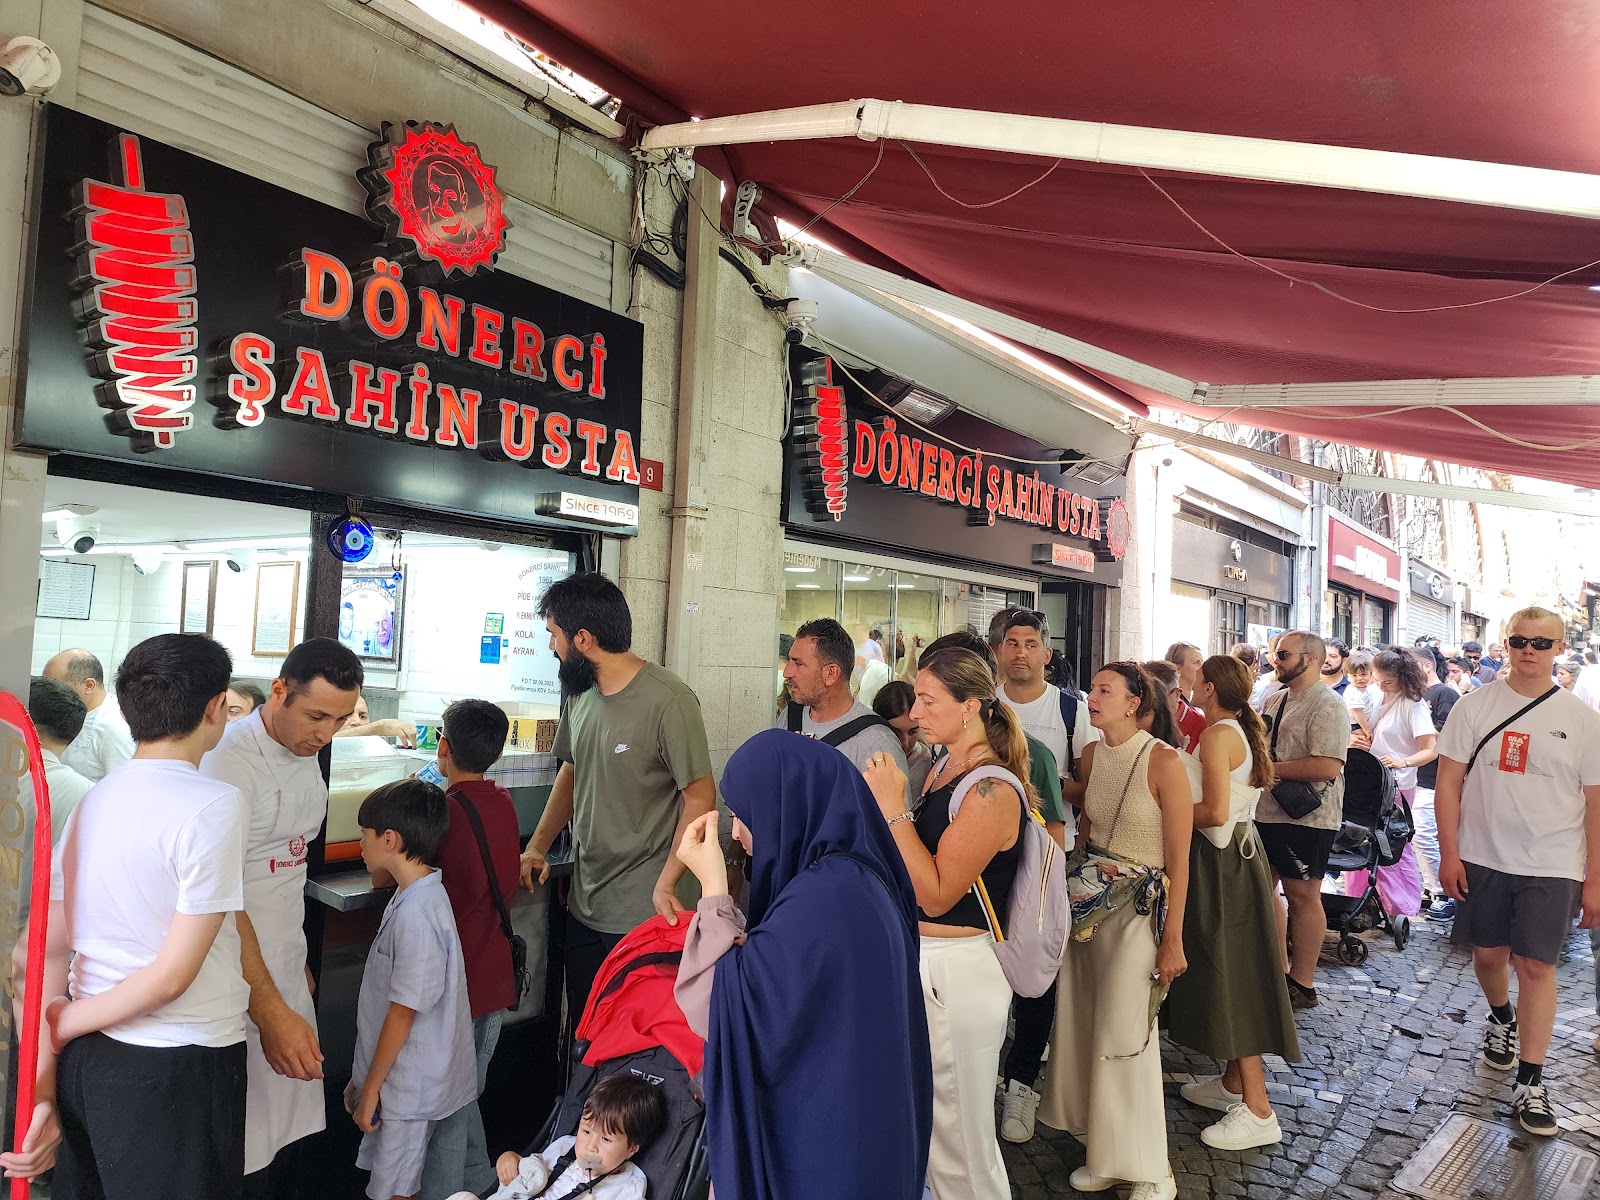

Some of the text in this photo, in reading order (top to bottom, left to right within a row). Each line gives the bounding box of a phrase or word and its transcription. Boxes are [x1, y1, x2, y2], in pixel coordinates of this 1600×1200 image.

[301, 247, 607, 399] DÖNERCİ
[228, 332, 641, 486] ŞAHİN USTA
[646, 467, 654, 483] 9
[853, 417, 1102, 541] DÖNERCİ ŞAHİN USTA
[603, 503, 635, 521] 1969
[513, 646, 535, 656] AYRAN
